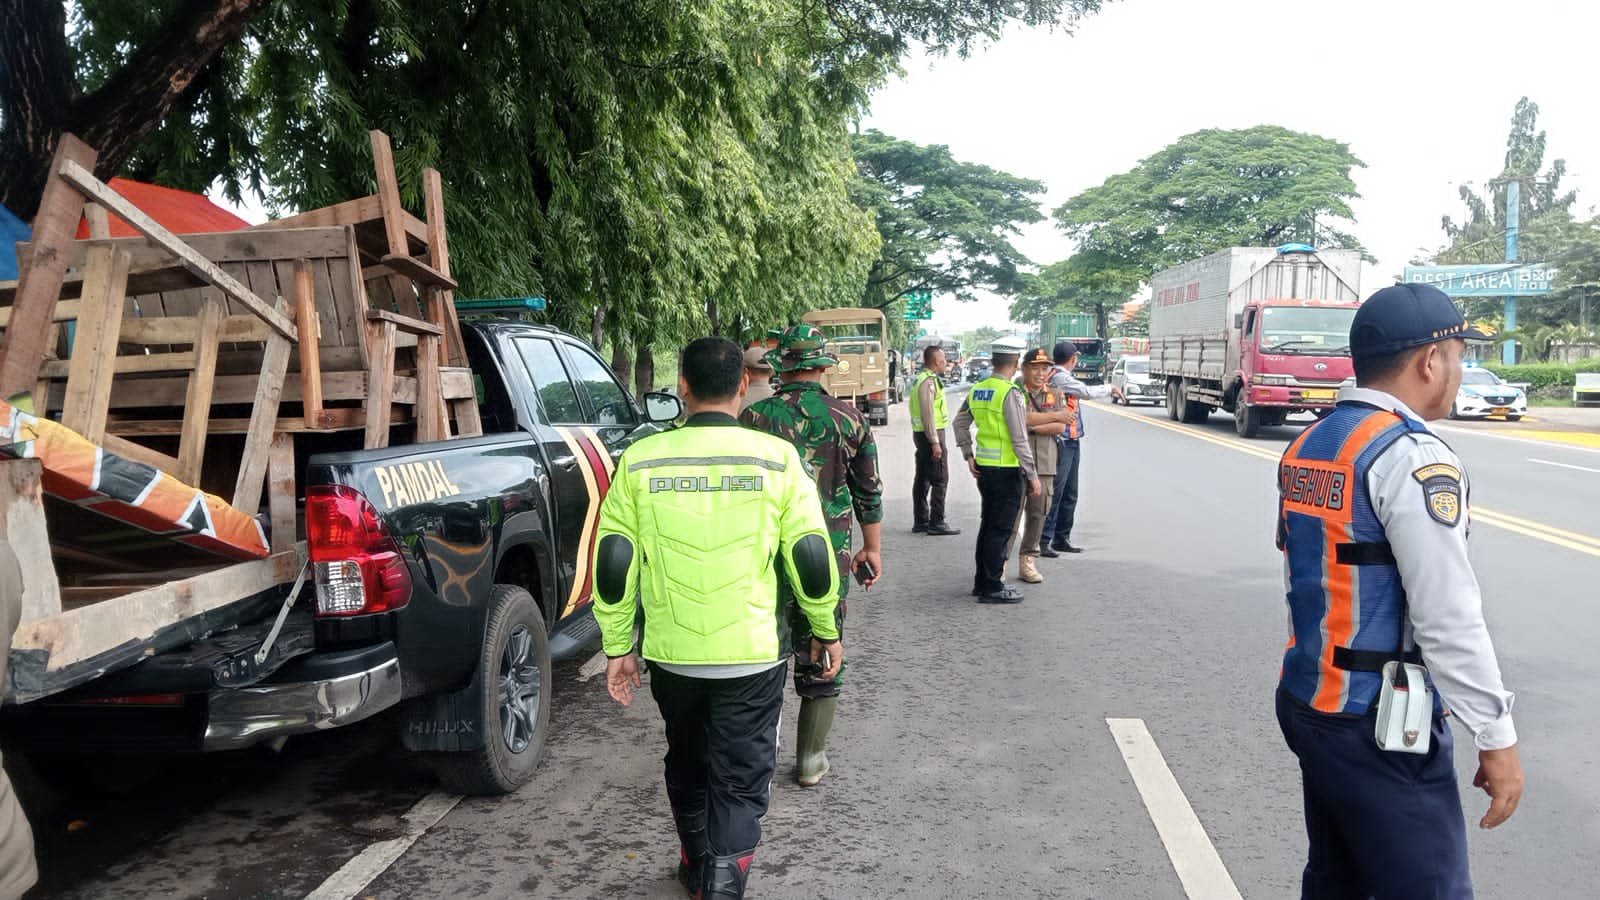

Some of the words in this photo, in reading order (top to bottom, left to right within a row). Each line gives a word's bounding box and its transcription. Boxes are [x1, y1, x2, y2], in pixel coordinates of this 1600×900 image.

[1461, 271, 1512, 289] AREA
[374, 460, 460, 508] PAMDAL
[649, 475, 763, 493] POLISI
[408, 719, 474, 735] HILUX
